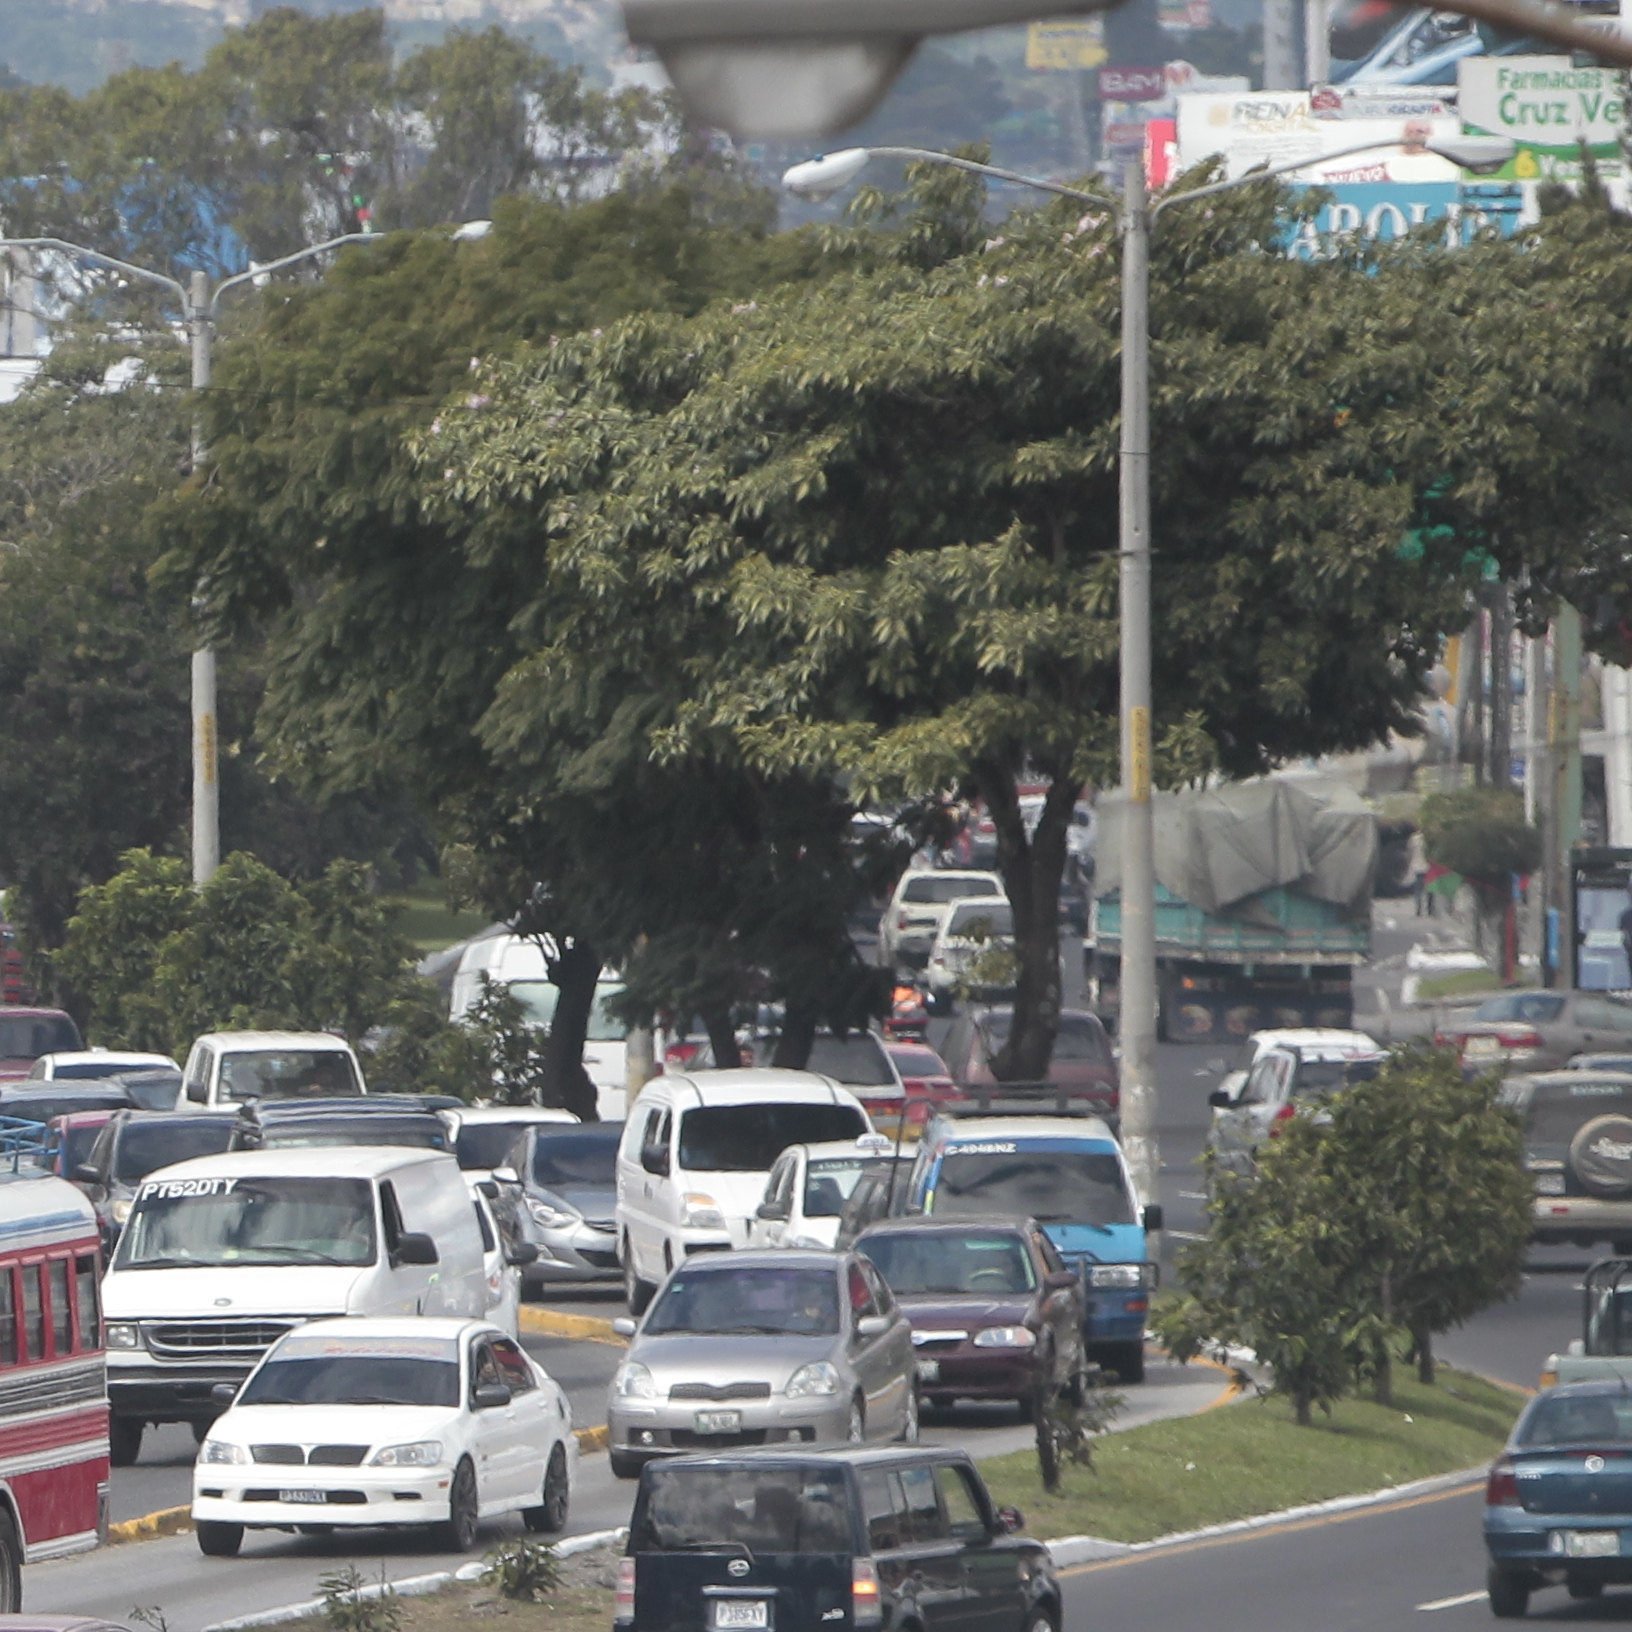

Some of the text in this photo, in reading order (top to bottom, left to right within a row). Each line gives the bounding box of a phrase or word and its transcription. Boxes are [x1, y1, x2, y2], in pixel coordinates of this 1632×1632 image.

[1498, 68, 1602, 90] Farmacias
[1499, 92, 1571, 125] Cruz
[141, 1179, 238, 1201] P752DTY
